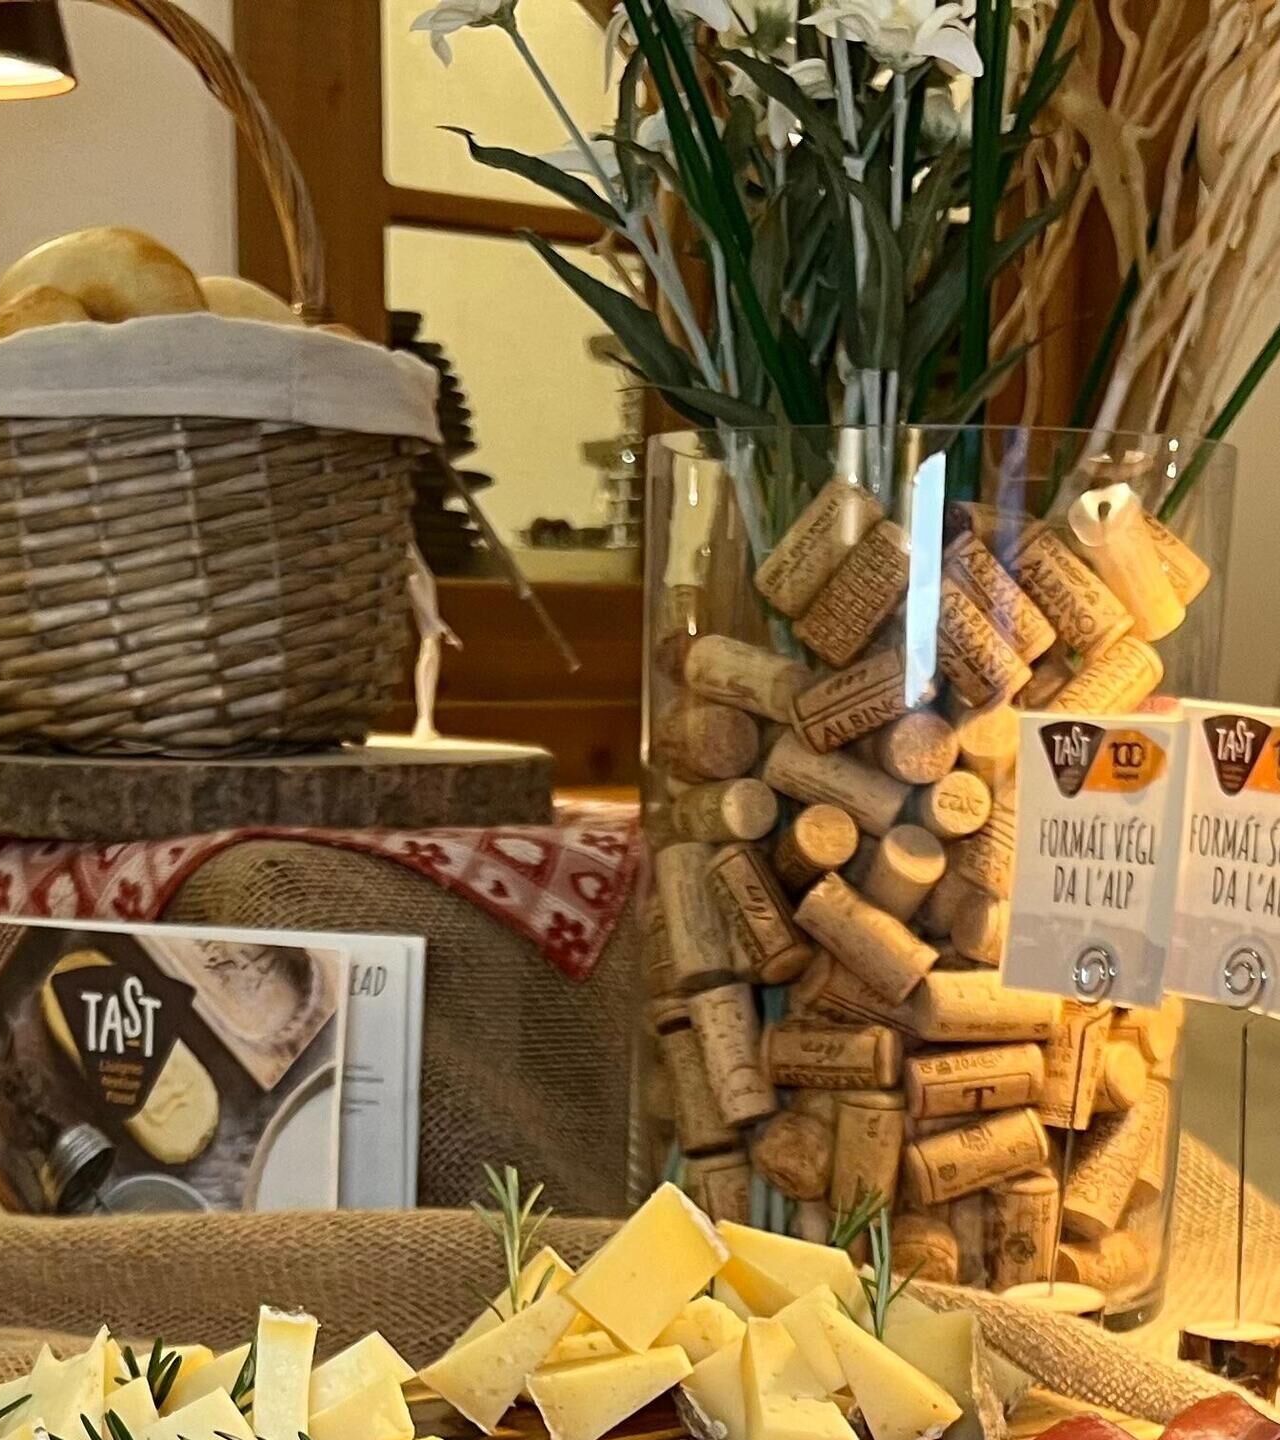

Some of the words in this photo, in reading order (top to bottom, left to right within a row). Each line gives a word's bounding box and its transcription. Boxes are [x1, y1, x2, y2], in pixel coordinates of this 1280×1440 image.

[1052, 725, 1091, 766] TAST
[1216, 719, 1256, 763] TAST
[1052, 864, 1076, 905] DA
[1212, 866, 1237, 908] DA
[80, 976, 162, 1058] TAST
